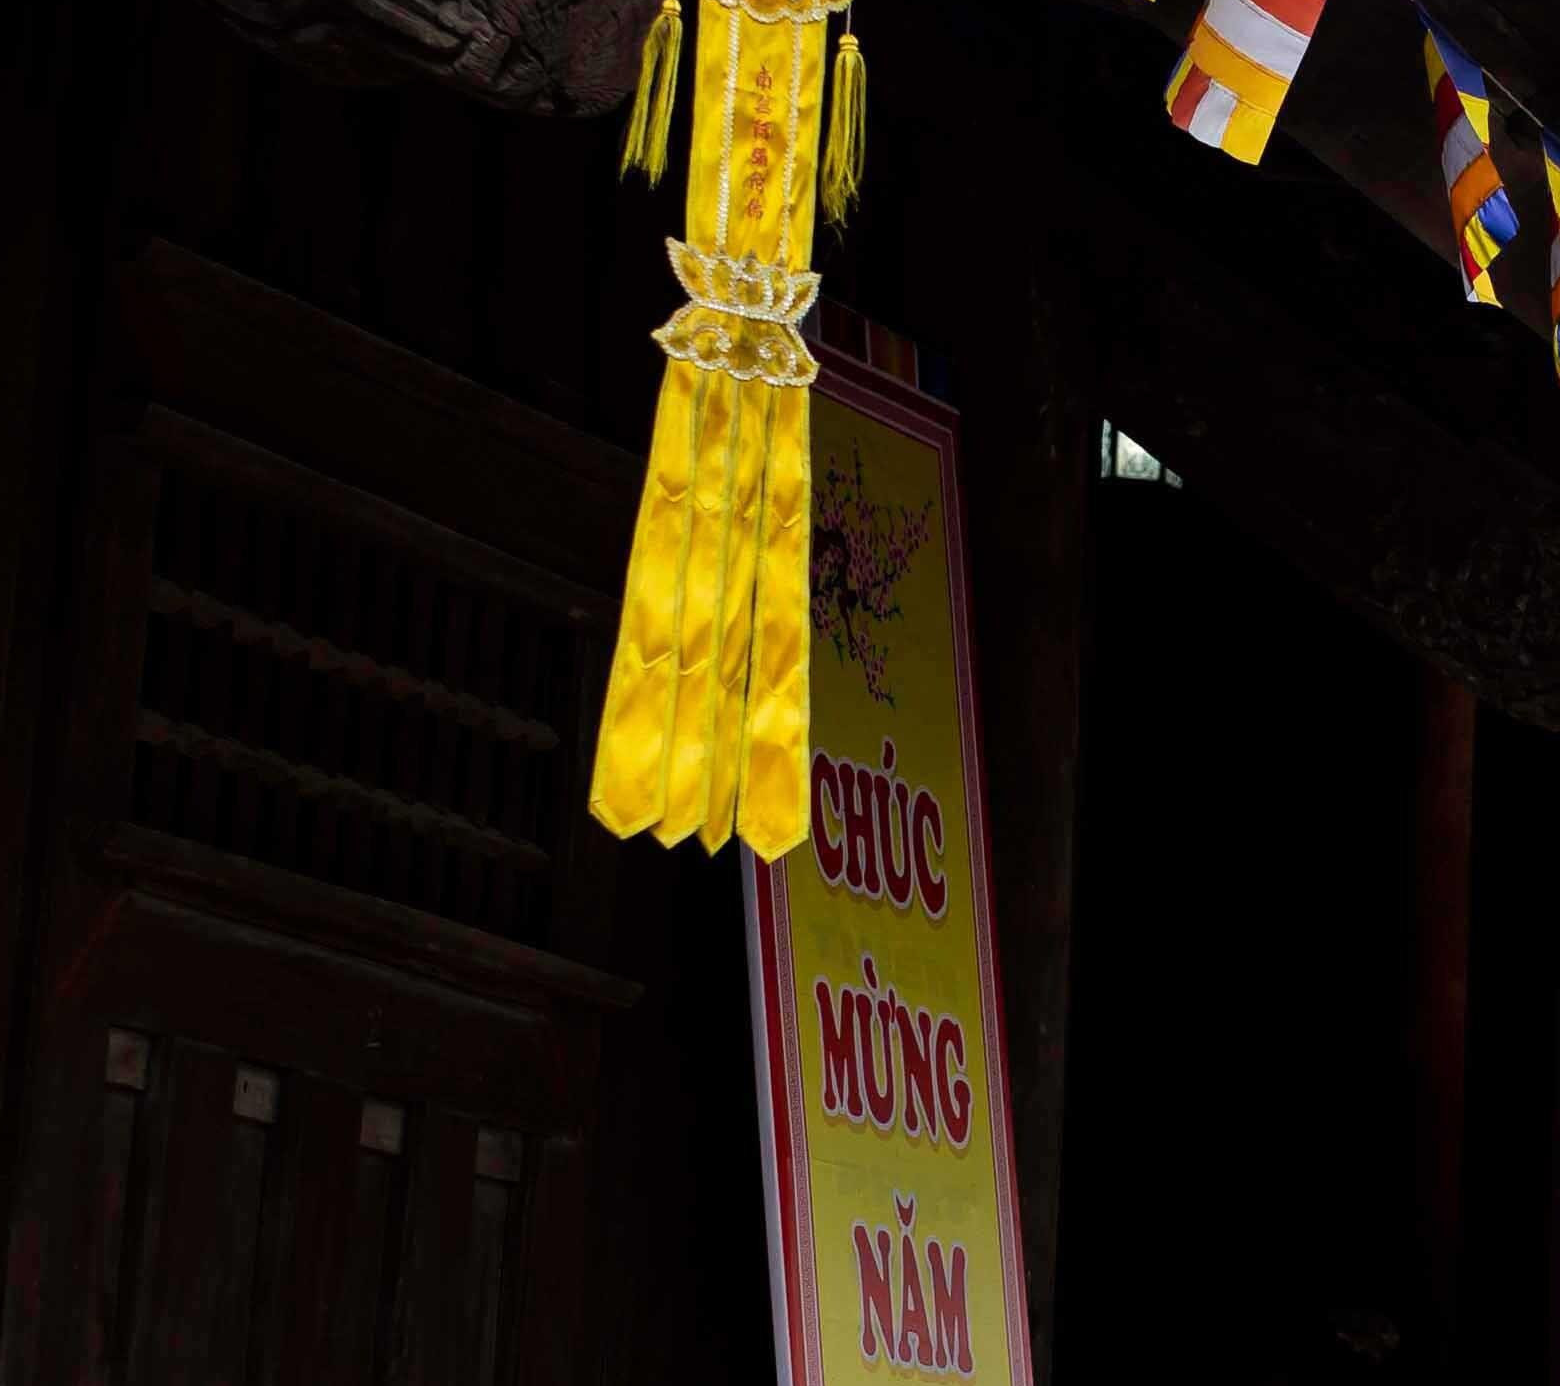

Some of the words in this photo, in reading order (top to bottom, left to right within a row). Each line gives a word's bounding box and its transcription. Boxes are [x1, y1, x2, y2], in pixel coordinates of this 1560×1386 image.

[810, 737, 947, 920] CHÚC
[815, 953, 973, 1149] MỪNG
[852, 1189, 975, 1377] NĂM
